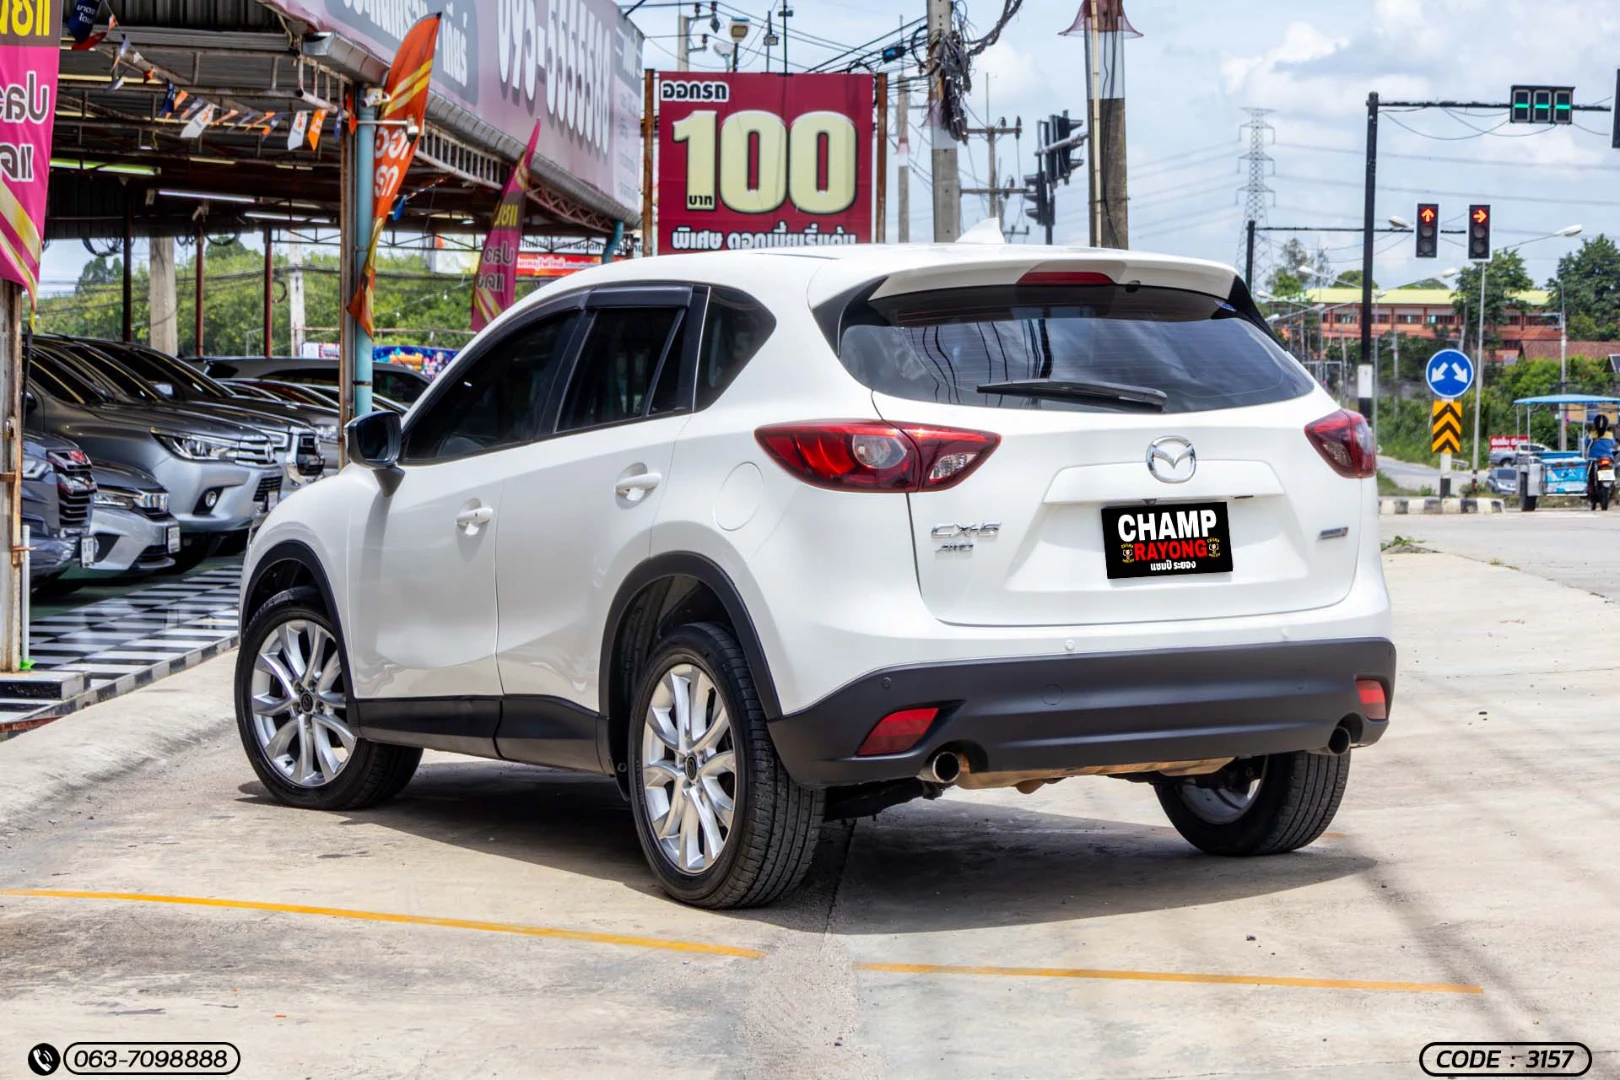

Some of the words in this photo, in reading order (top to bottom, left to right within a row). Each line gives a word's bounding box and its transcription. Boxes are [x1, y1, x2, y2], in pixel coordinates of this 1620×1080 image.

[661, 81, 728, 101] ออกรถ
[672, 109, 857, 215] 100
[688, 194, 713, 206] บาท
[672, 227, 724, 249] พิเศษ
[1117, 509, 1217, 543] CHAMP
[1133, 539, 1208, 561] RAYONG
[1173, 560, 1196, 570] ระยอง
